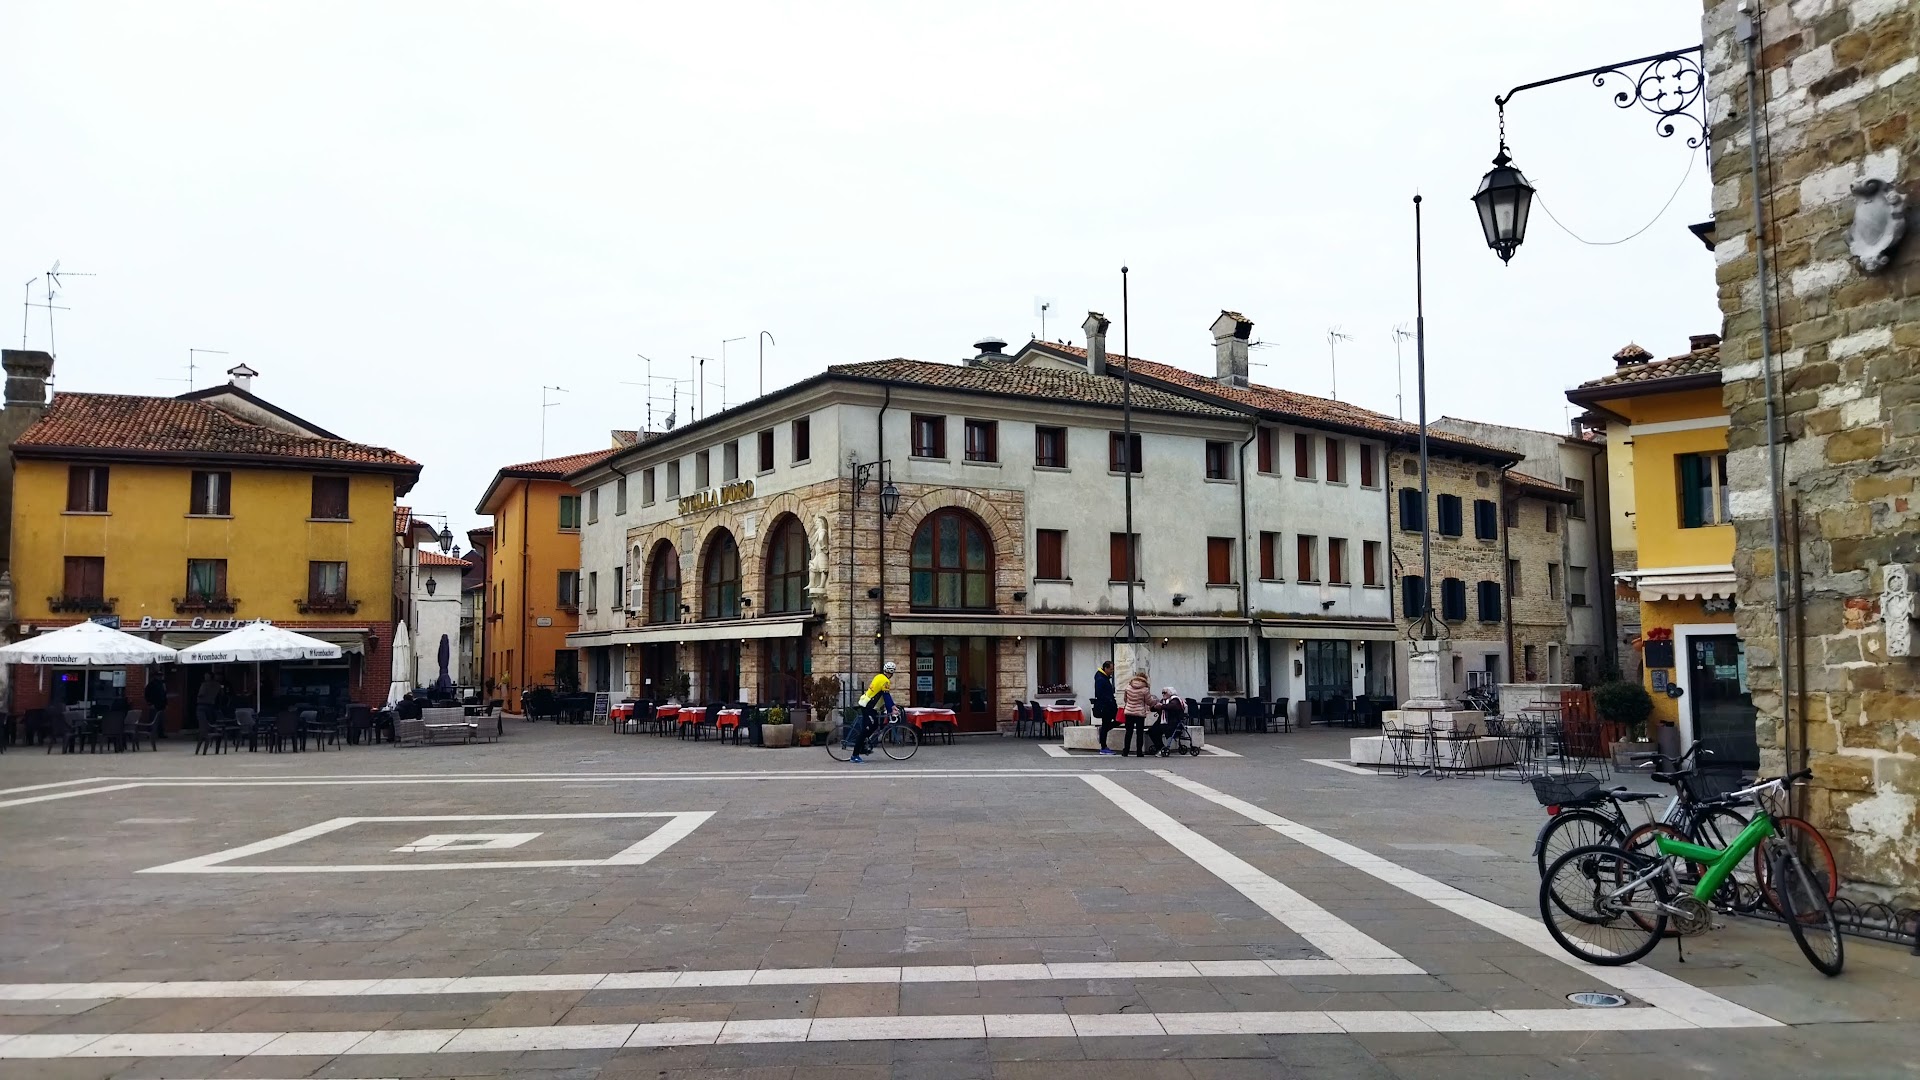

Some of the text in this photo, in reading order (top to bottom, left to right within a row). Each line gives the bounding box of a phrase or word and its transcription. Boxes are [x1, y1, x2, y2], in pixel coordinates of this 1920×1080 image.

[678, 488, 719, 515] STELLA
[140, 616, 272, 629] Bar Centrae
[40, 653, 78, 663] Krombacher
[197, 652, 228, 661] Krombacher
[313, 649, 335, 657] Krombacher
